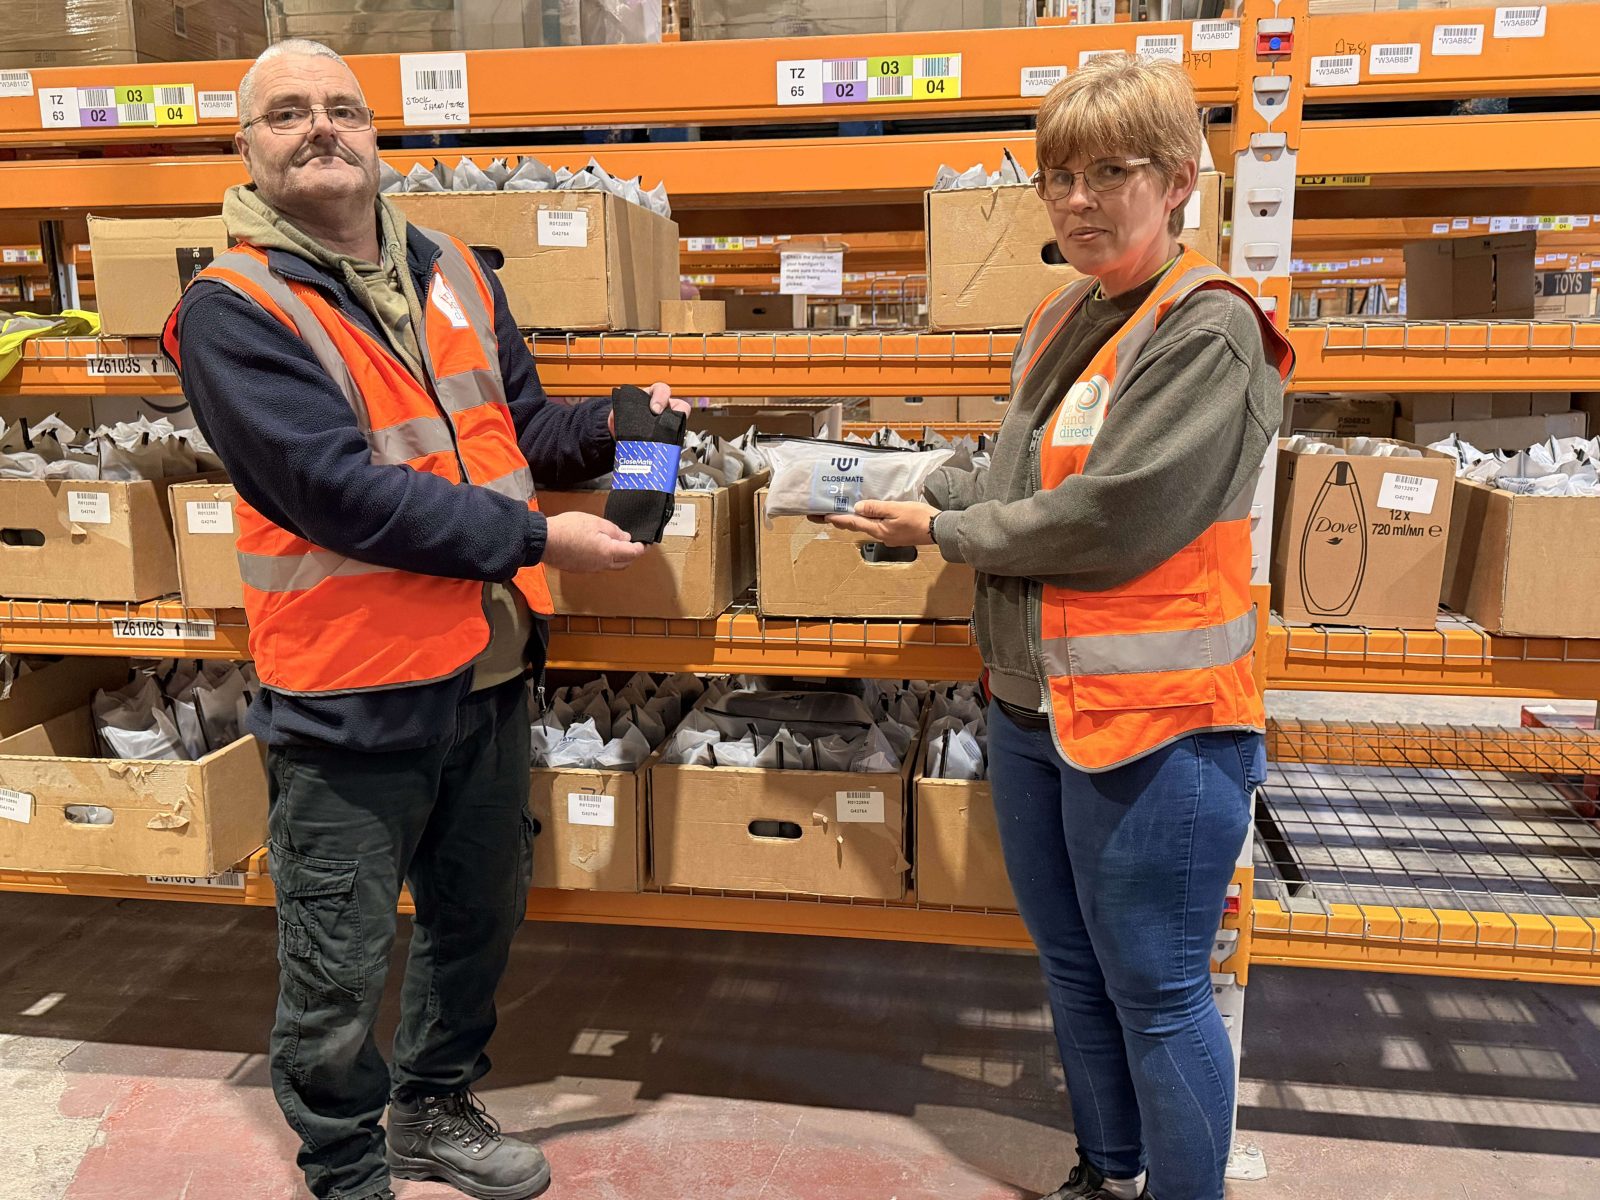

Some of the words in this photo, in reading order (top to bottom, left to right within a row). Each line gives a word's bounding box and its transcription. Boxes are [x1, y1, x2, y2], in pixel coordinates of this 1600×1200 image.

[790, 68, 805, 79] TZ
[881, 61, 899, 75] 03
[790, 86, 804, 97] 65
[836, 83, 854, 97] 02
[926, 80, 945, 94] 04
[50, 95, 63, 105] TZ
[126, 90, 143, 102] 03
[53, 111, 64, 121] 63
[90, 110, 107, 122] 02
[167, 107, 183, 120] 04
[444, 113, 462, 121] ETC
[1554, 273, 1583, 294] TOYS
[88, 358, 141, 373] TZ6103S
[1060, 426, 1094, 438] direct
[821, 475, 864, 483] CLOSEMATE
[1389, 509, 1402, 521] 12
[1315, 517, 1358, 534] Dove
[1371, 523, 1391, 536] 720
[114, 620, 165, 637] TZ6102S
